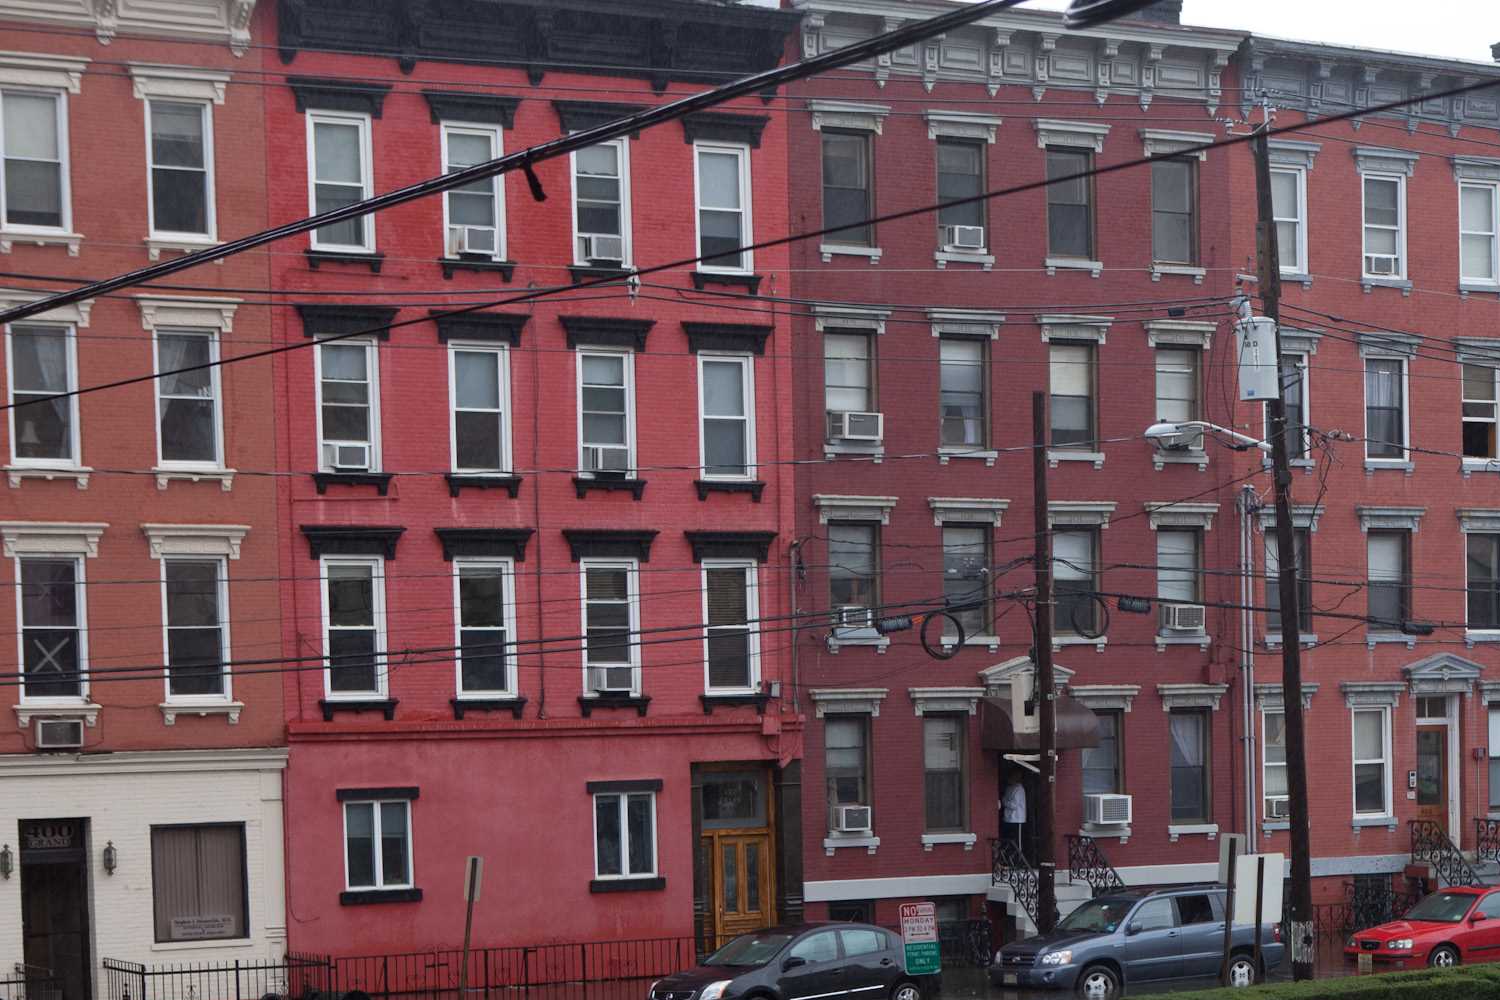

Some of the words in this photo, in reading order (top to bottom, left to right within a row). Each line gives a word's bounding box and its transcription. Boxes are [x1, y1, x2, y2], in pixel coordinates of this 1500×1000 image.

[24, 823, 74, 839] 400
[903, 906, 917, 917] NO
[904, 917, 934, 925] MONDAY
